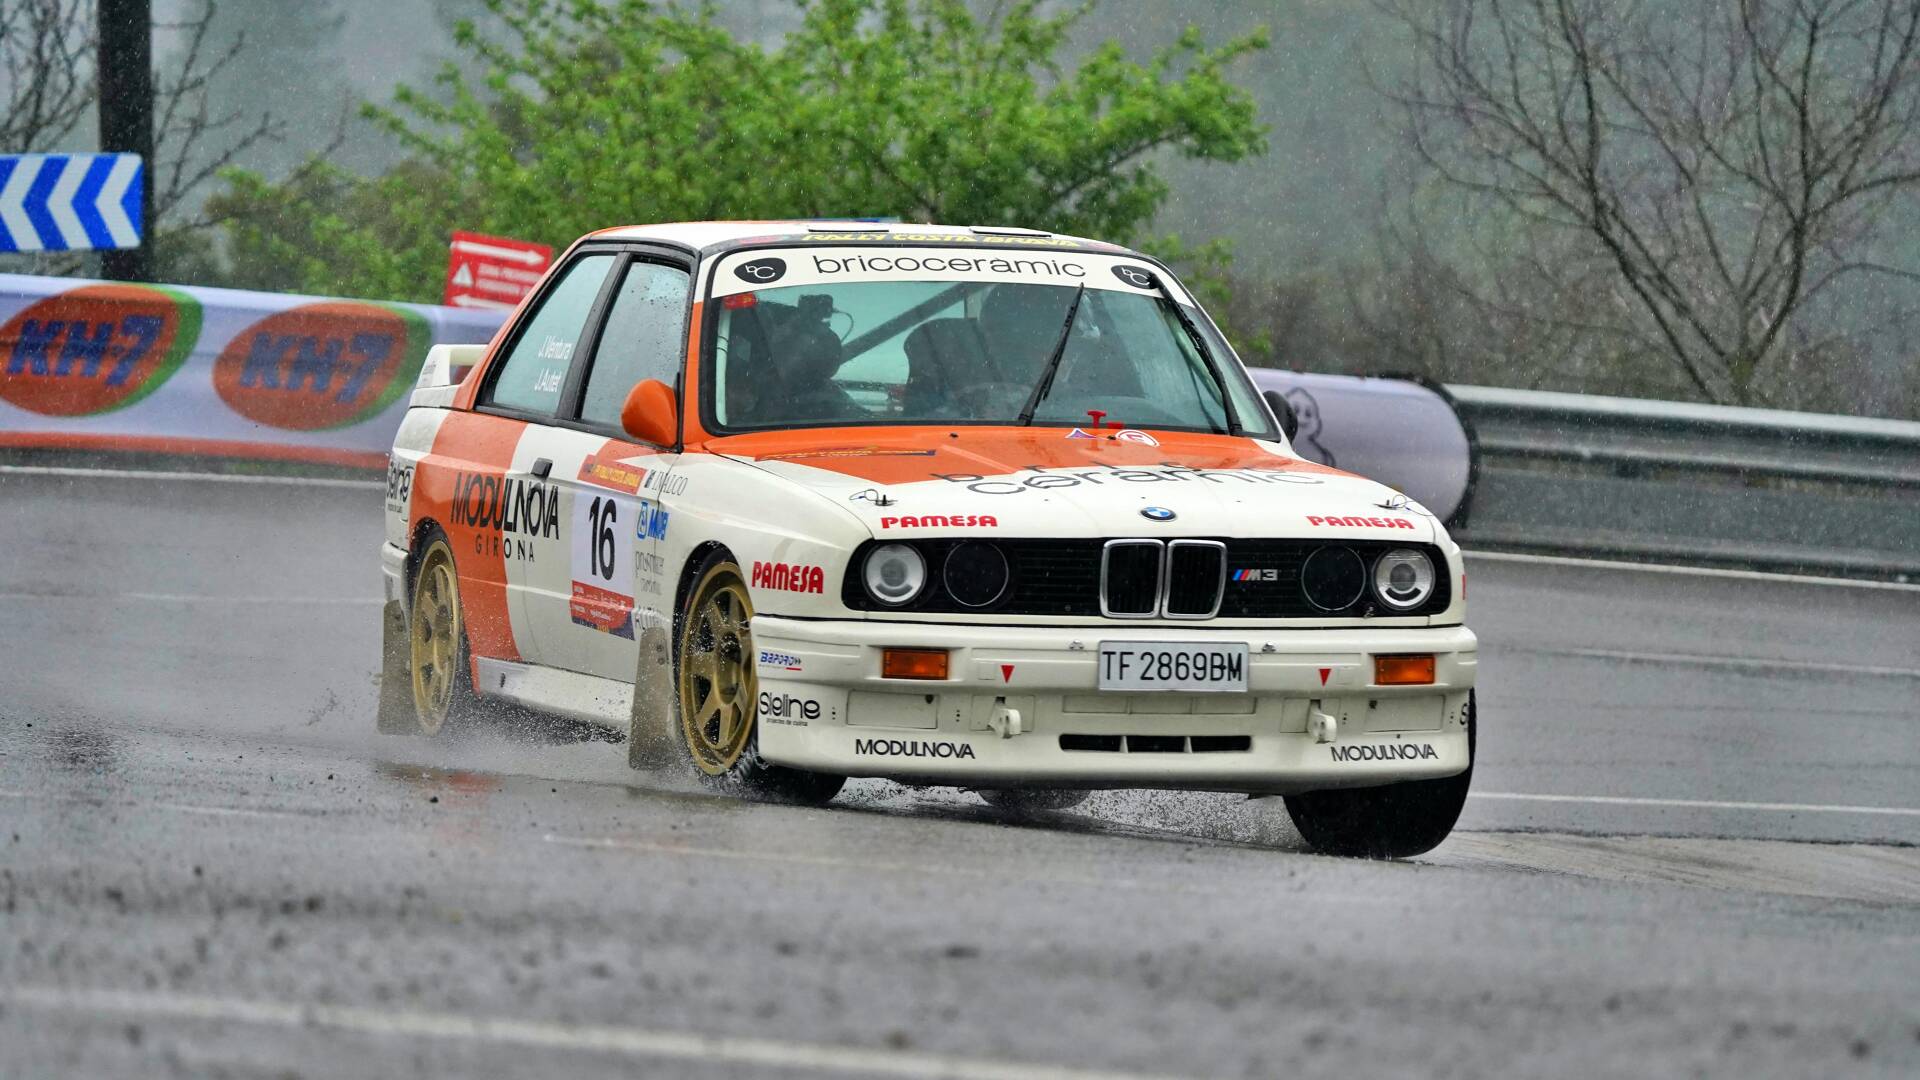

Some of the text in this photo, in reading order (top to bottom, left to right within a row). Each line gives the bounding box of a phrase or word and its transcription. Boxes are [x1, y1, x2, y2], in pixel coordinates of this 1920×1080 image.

[812, 255, 1087, 278] bricoceramic
[7, 315, 165, 386] KH-7
[240, 332, 393, 403] KH-7
[451, 472, 560, 540] MODULNOVA
[880, 515, 998, 530] PAMESA
[1305, 515, 1415, 530] PAMESA
[474, 533, 536, 563] GIRONA
[588, 496, 617, 581] 16
[751, 561, 825, 594] PAMESA
[1247, 568, 1278, 582] M3
[1101, 651, 1136, 683] TF
[855, 738, 976, 759] MODULNOVA
[1330, 743, 1440, 762] MODULNOVA
